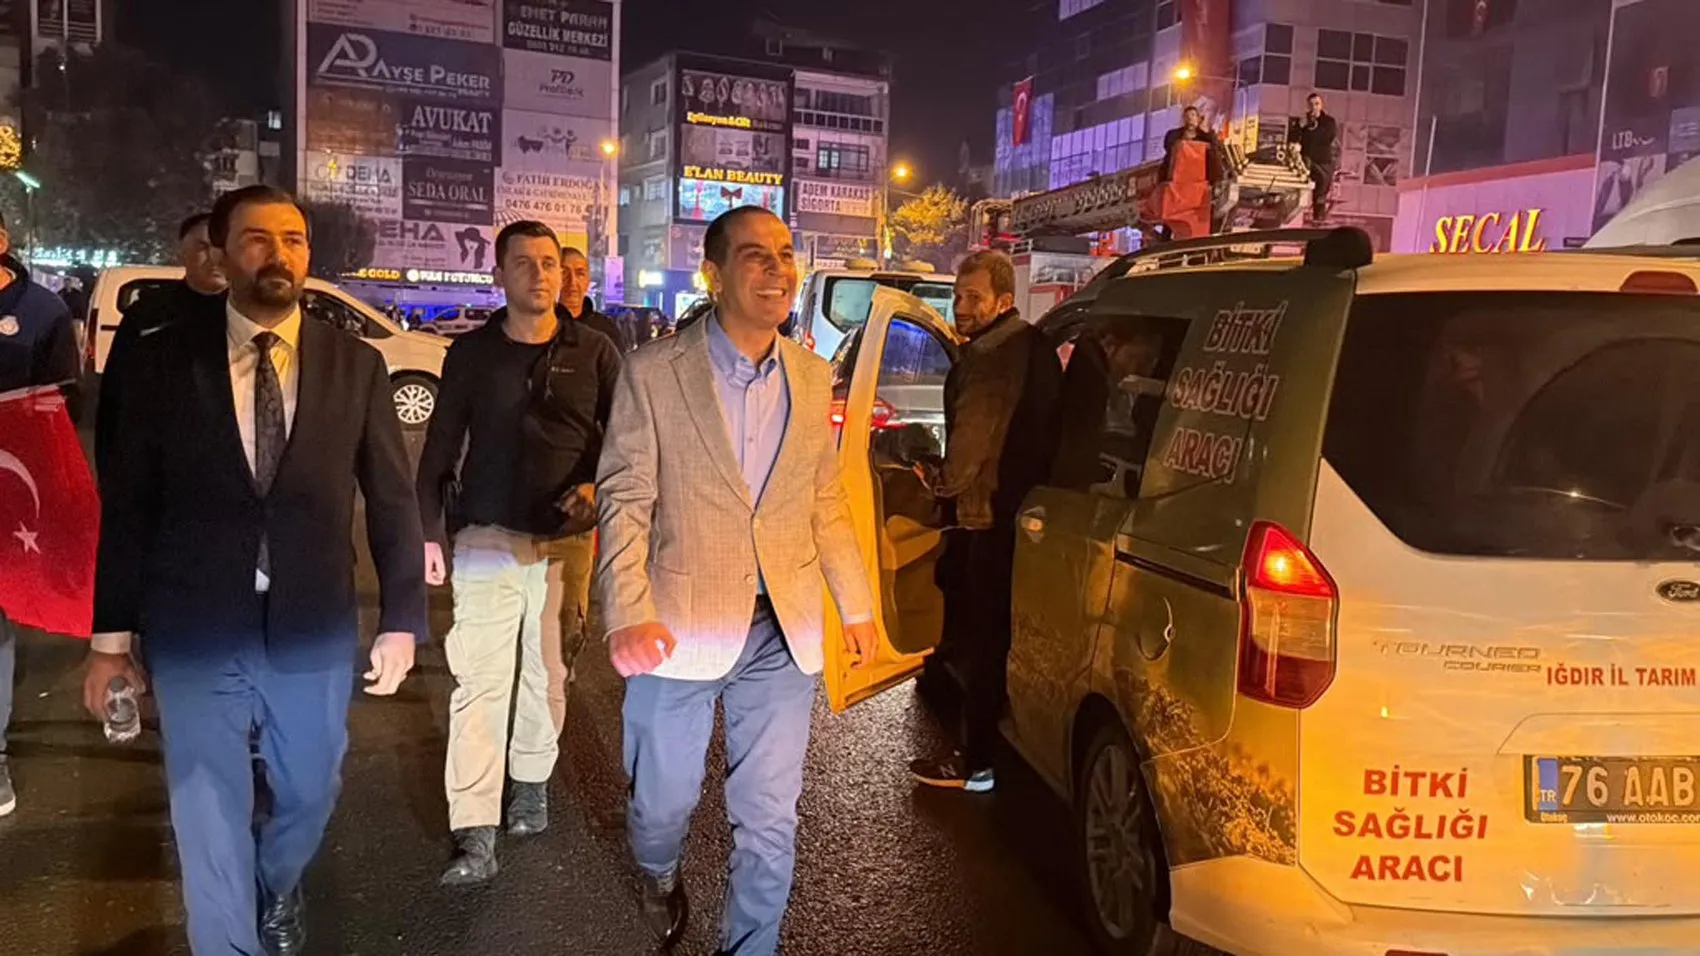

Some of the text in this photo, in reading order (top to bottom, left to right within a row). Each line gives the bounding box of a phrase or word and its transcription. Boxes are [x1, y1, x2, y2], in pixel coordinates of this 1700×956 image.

[371, 57, 490, 89] AYŞE PEKER
[411, 105, 492, 134] AVUKAT
[408, 180, 445, 199] SEDA
[448, 185, 488, 203] ORAL
[727, 169, 783, 185] BEAUTY
[372, 220, 445, 241] EHA
[1429, 208, 1545, 253] SECAL
[367, 268, 400, 280] GOLD
[1204, 300, 1289, 354] BİTKİ
[1171, 360, 1280, 421] SAĞLIĞI
[1163, 427, 1244, 484] ARACI
[1443, 660, 1541, 673] COURIER
[1547, 662, 1696, 687] IĞDIR İL TARIM
[1363, 764, 1468, 798] BİTKİ
[1540, 765, 1695, 806] TR 76 AAB
[1333, 808, 1488, 839] SAĞLIĞI
[1350, 855, 1463, 882] ARACI
